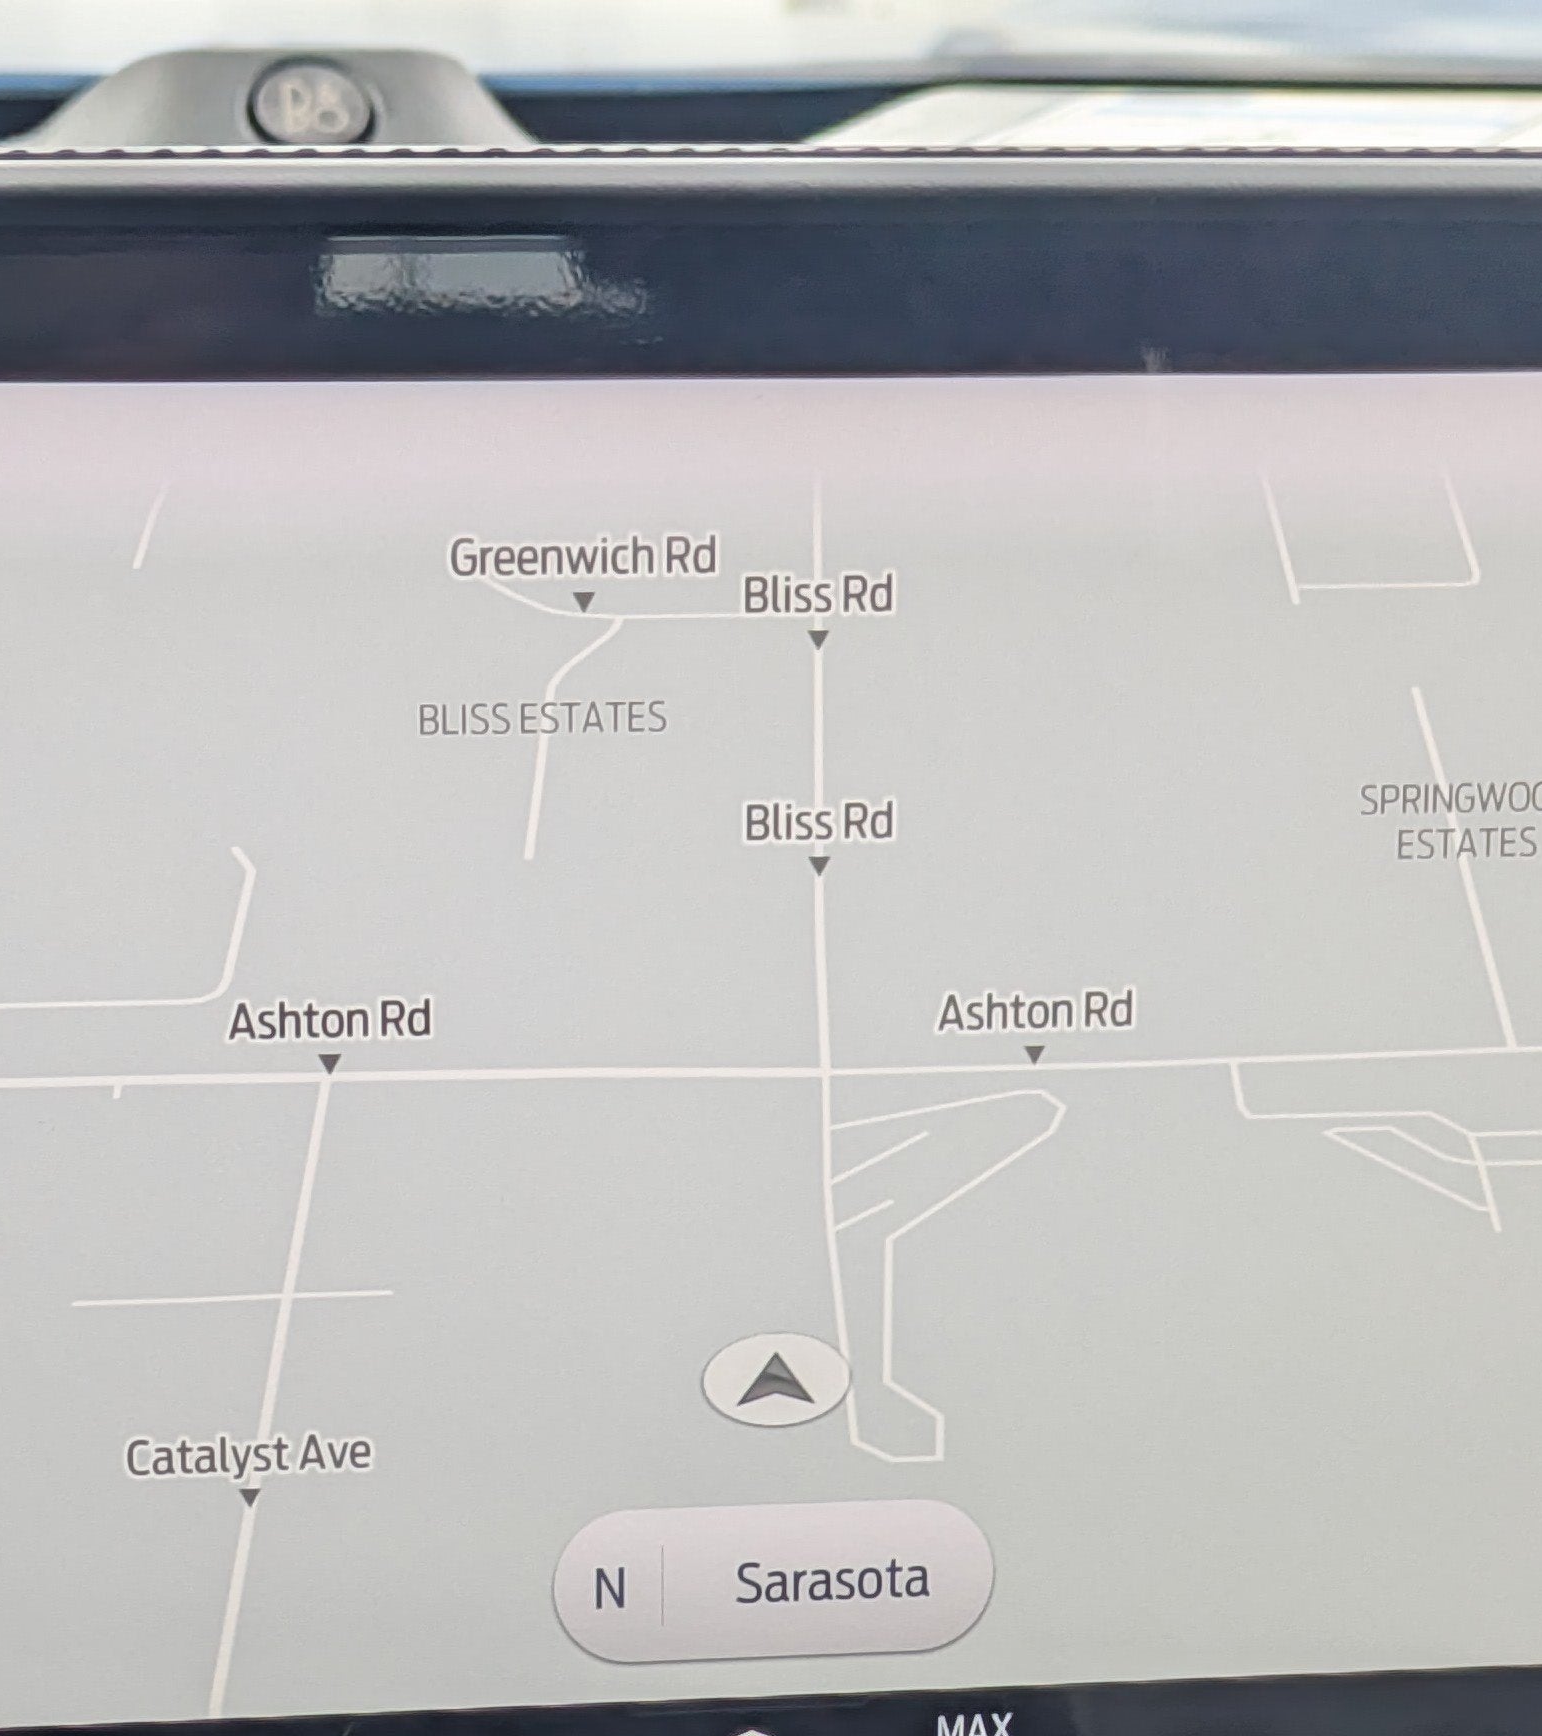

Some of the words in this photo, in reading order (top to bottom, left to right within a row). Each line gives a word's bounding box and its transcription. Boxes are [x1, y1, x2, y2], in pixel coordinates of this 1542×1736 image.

[450, 536, 654, 577] Greenwich
[666, 535, 716, 574] Rd
[744, 574, 832, 613] Bliss
[843, 573, 892, 612] Rd
[419, 702, 511, 736] BLISS
[520, 700, 667, 734] ESTATES
[746, 803, 833, 841] Bliss
[844, 800, 893, 839] Rd
[1397, 826, 1538, 860] ESTATES
[229, 1001, 369, 1040] Ashton
[381, 998, 431, 1037] Rd
[938, 992, 1073, 1031] Ashton
[1084, 989, 1133, 1027] Rd
[127, 1436, 290, 1480] Catalyst
[299, 1434, 371, 1470] Ave
[596, 1566, 625, 1610] N
[736, 1558, 930, 1604] Sarasota
